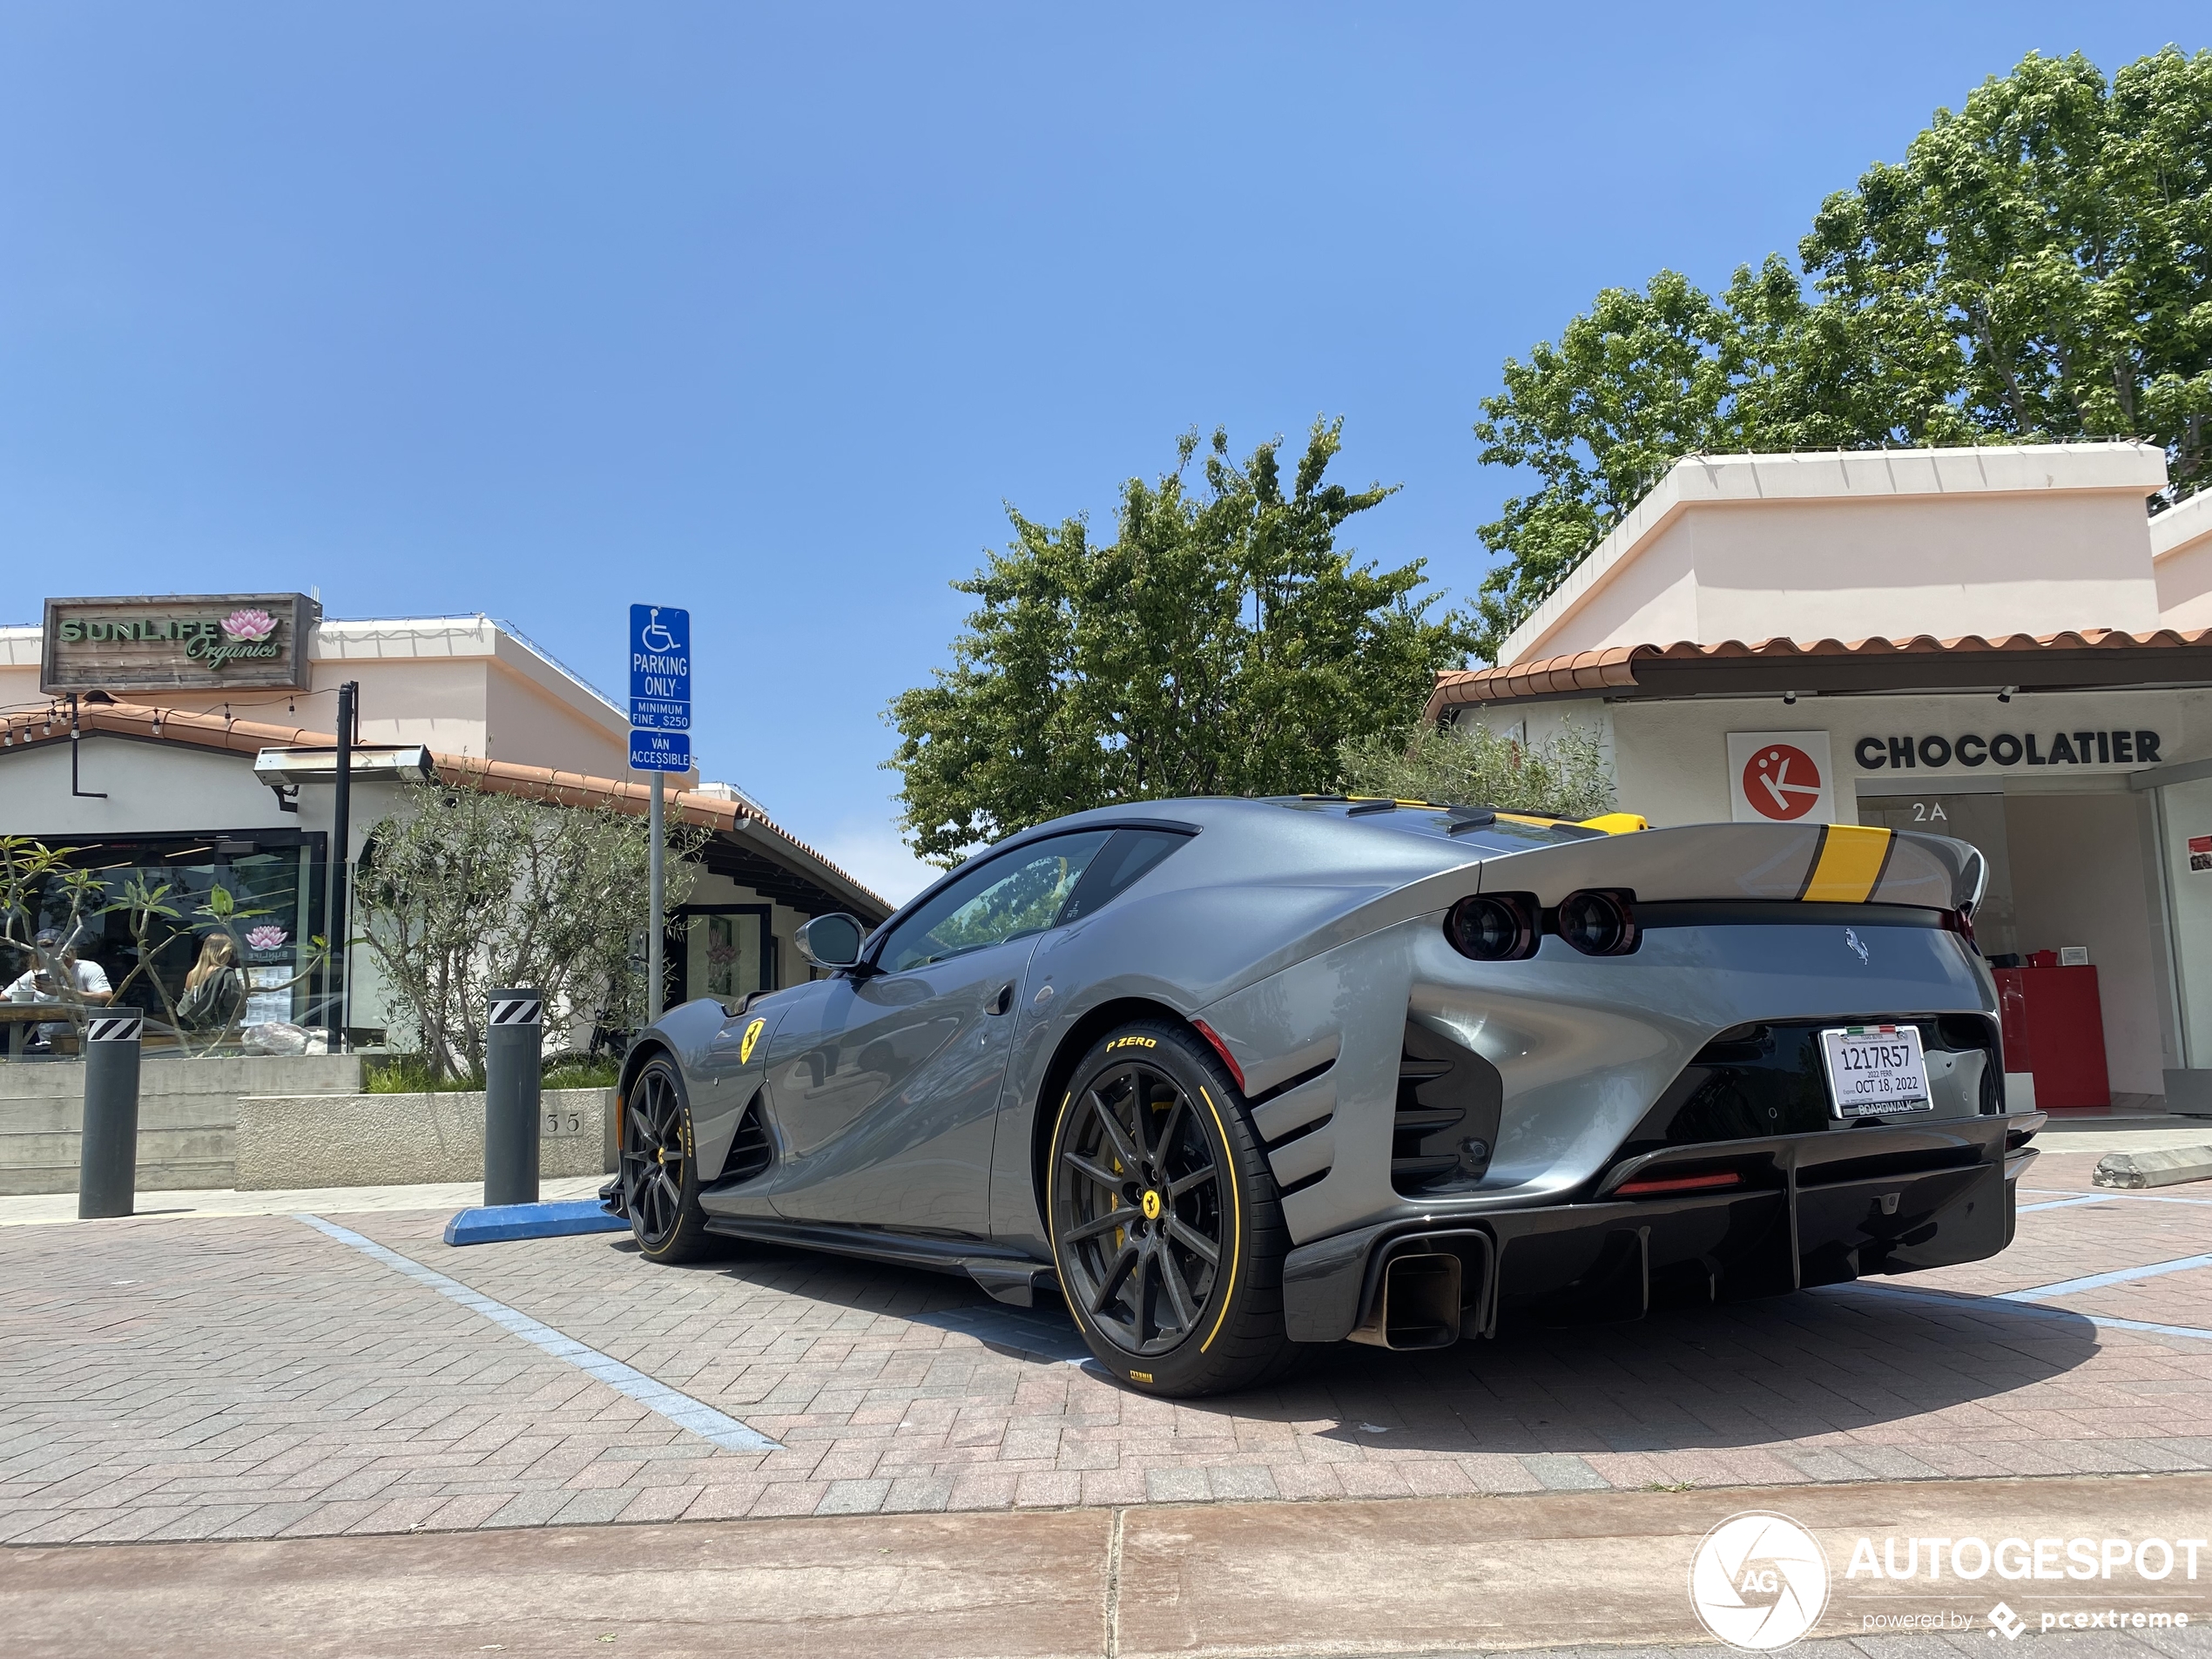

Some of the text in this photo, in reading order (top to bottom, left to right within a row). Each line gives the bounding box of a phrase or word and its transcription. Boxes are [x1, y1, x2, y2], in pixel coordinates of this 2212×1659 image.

[184, 633, 279, 670] Organics
[633, 653, 687, 677] PARKING
[644, 676, 677, 698] ONLY
[637, 702, 683, 715] MINIMUM
[632, 713, 688, 727] FINE $250
[651, 737, 670, 751] VAN
[1854, 730, 2162, 770] CHOCOLATIER
[631, 751, 689, 766] ACCESSIBLE
[1912, 800, 1947, 822] 2A
[1106, 1036, 1157, 1053] P ZERO
[1841, 1045, 1909, 1070] 1217R57
[1856, 1079, 1875, 1094] OCT
[1878, 1078, 1893, 1094] 18,
[1895, 1076, 1918, 1090] 2022
[1858, 1100, 1913, 1116] BOARDWALK
[546, 1112, 579, 1133] 35
